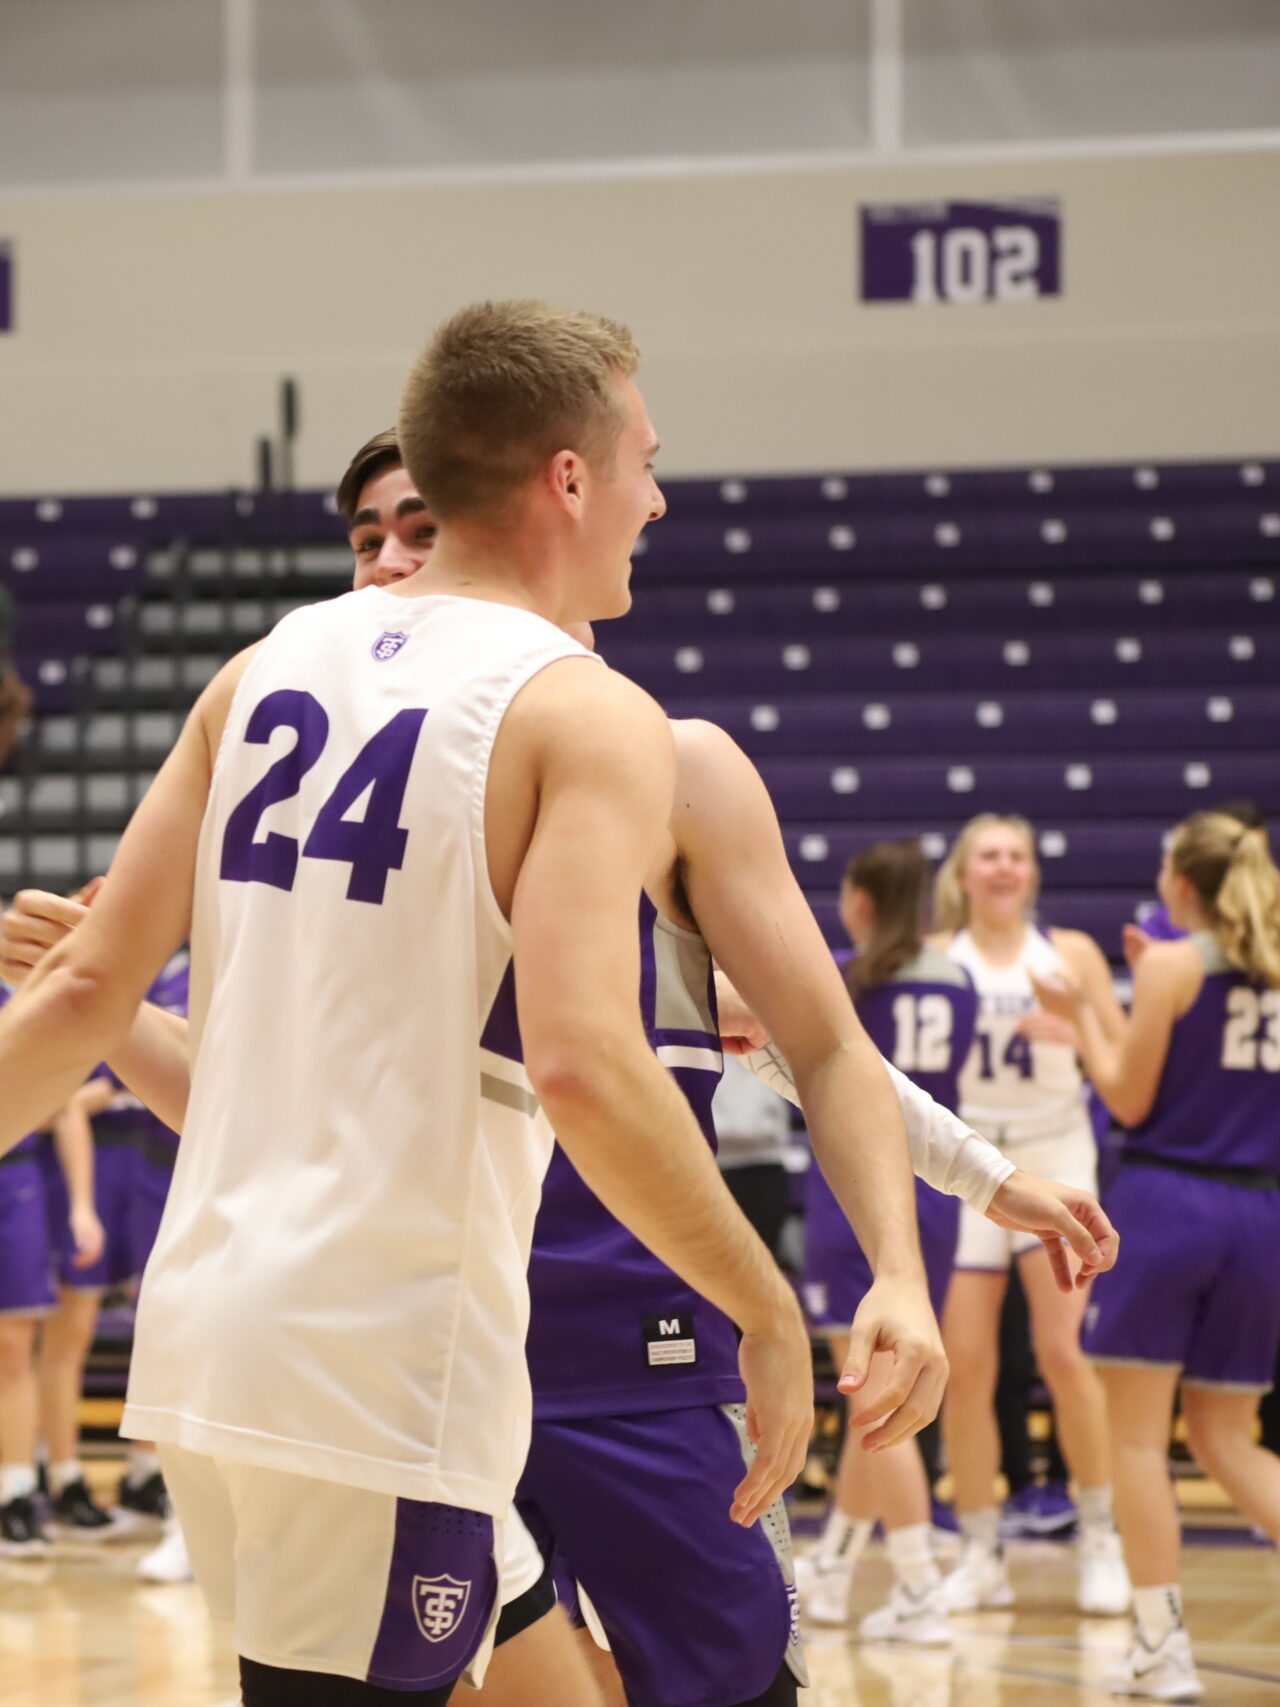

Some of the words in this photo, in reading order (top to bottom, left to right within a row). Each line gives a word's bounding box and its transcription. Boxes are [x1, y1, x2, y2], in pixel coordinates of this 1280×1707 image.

[911, 225, 1040, 306] 102
[220, 688, 429, 905] 24
[892, 993, 953, 1073] 12
[977, 1030, 1035, 1081] 14
[658, 1318, 680, 1335] M
